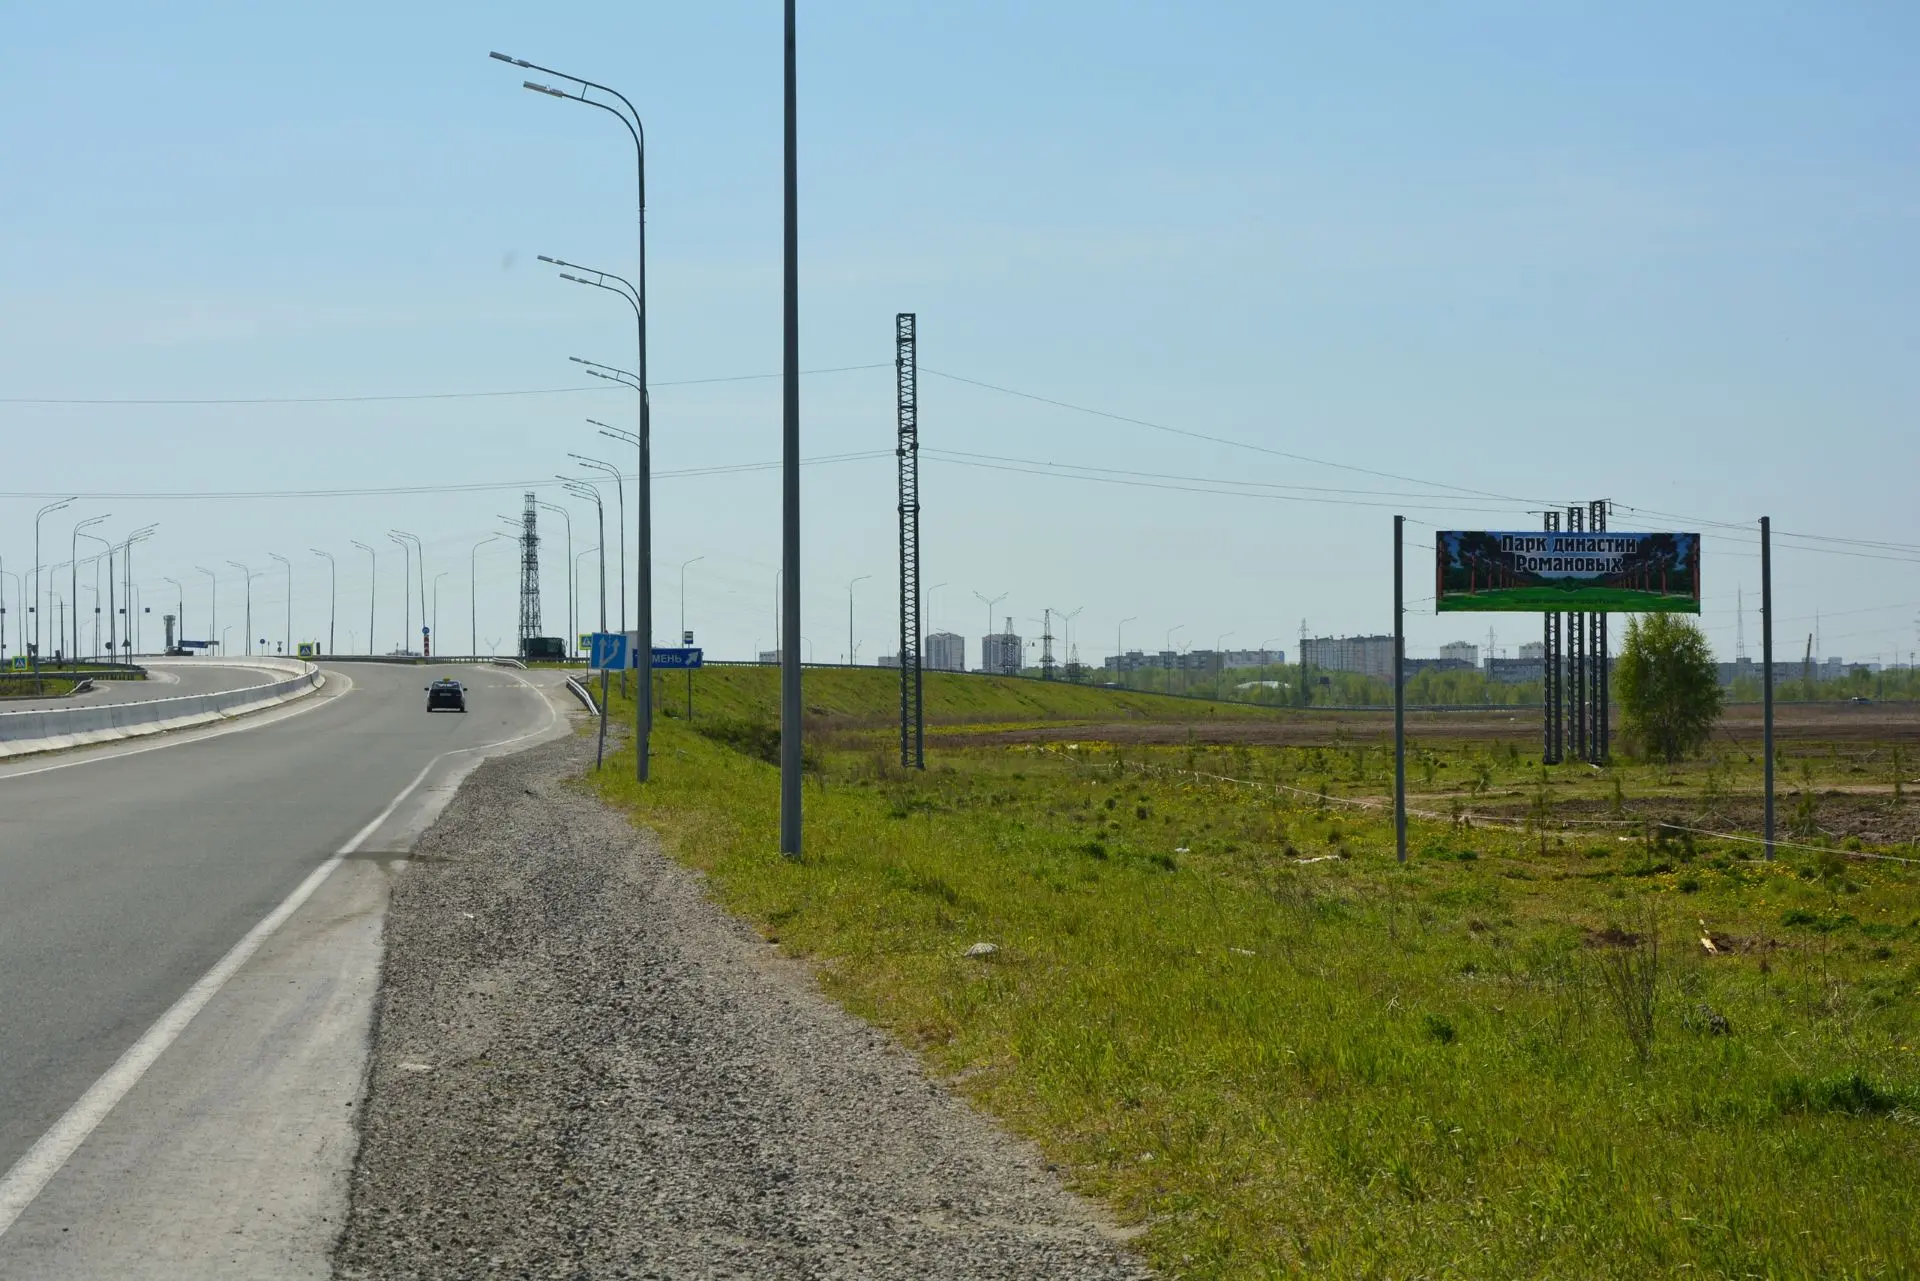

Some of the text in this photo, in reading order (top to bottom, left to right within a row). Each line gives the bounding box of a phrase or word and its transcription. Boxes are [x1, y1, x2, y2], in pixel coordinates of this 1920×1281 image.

[1501, 534, 1637, 554] Парк династии
[1514, 554, 1624, 572] Романовых
[635, 654, 682, 663] МЕНЬ
